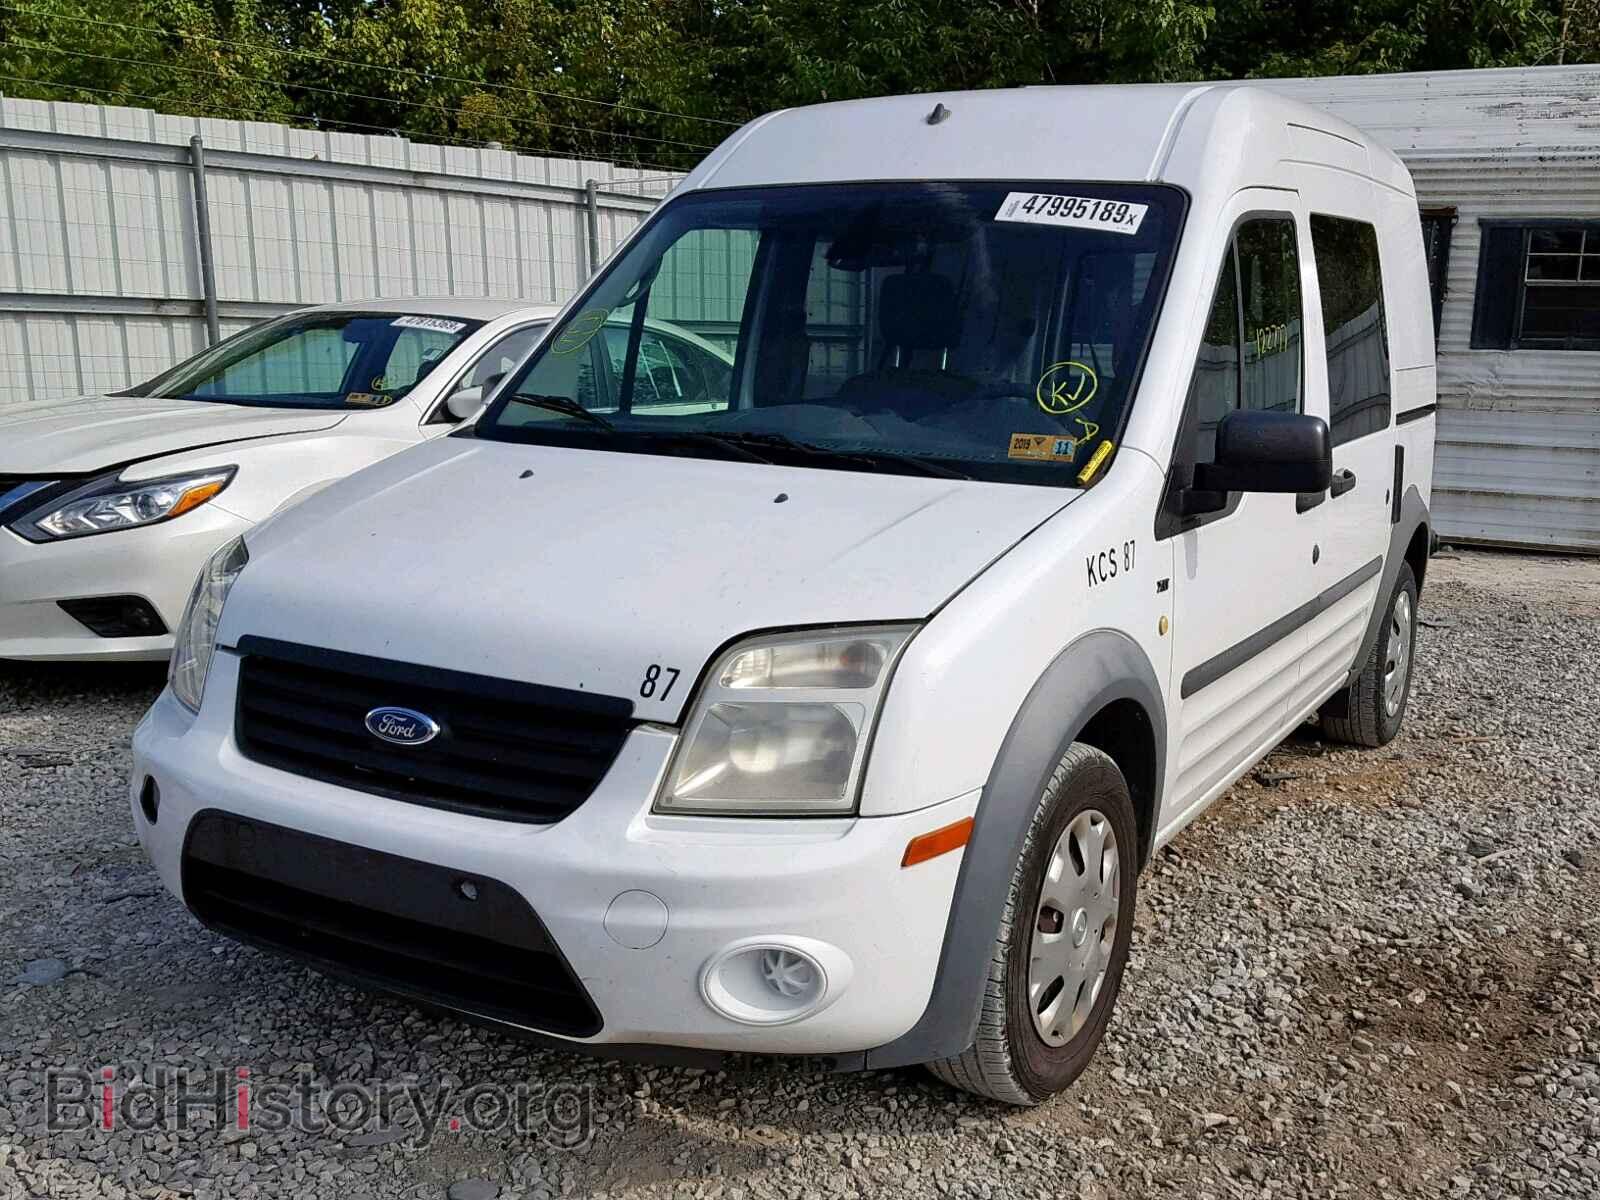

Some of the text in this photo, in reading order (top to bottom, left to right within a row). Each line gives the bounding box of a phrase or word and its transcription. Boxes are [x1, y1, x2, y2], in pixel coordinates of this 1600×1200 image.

[1056, 440, 1070, 455] 11
[1086, 539, 1136, 588] KCS 87
[639, 663, 681, 702] 87
[378, 713, 416, 738] Ford
